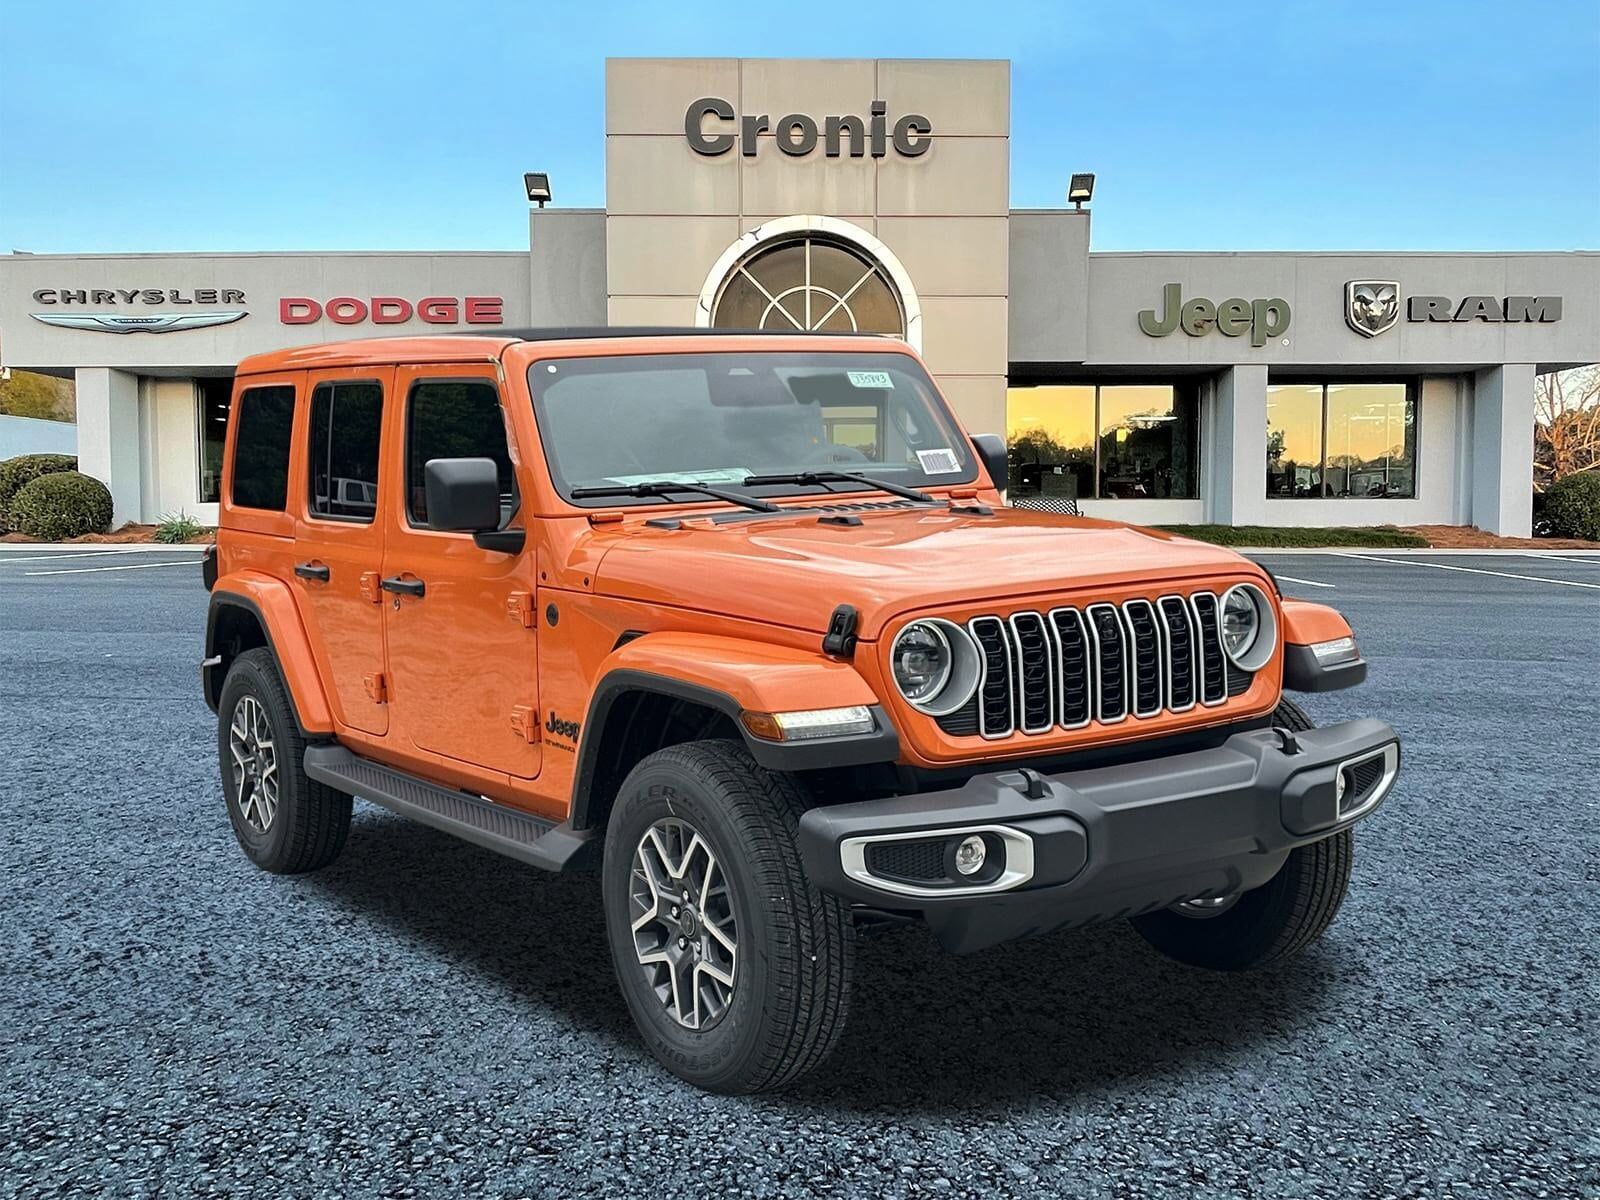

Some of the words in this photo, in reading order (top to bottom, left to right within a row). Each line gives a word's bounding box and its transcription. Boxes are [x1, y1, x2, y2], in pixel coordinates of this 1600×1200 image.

[684, 97, 932, 158] Cronic
[32, 288, 247, 305] CHRYSLER
[279, 297, 504, 325] DODGE
[1407, 296, 1563, 322] RAM
[1138, 283, 1291, 347] Jeep
[545, 711, 580, 744] Jeep
